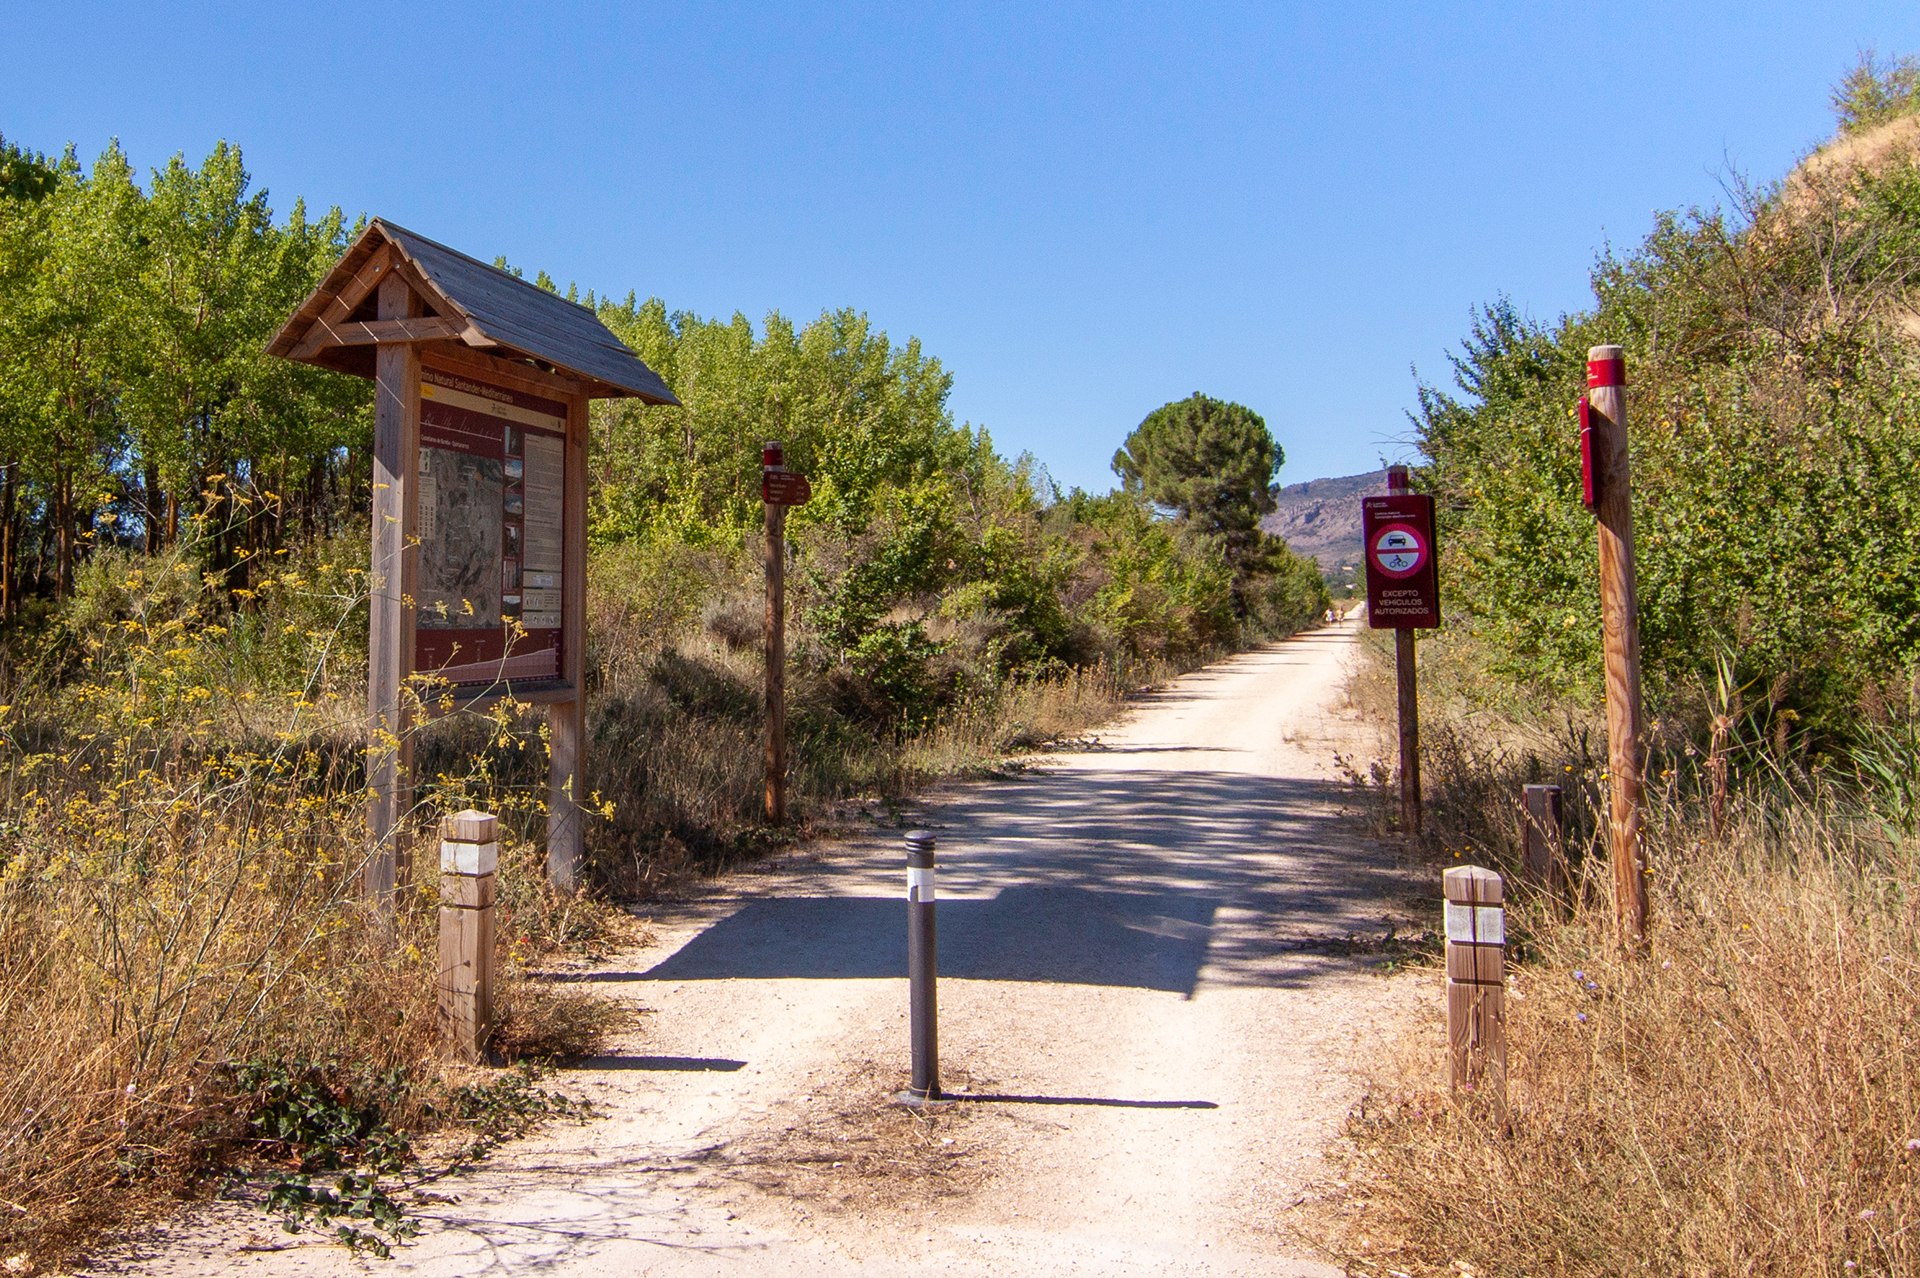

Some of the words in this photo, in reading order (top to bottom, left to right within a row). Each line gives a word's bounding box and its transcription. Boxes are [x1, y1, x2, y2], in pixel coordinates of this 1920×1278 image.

[434, 373, 454, 388] Natural
[1382, 590, 1419, 598] EXCEPTO
[1374, 607, 1429, 615] AUTORIZADOS
